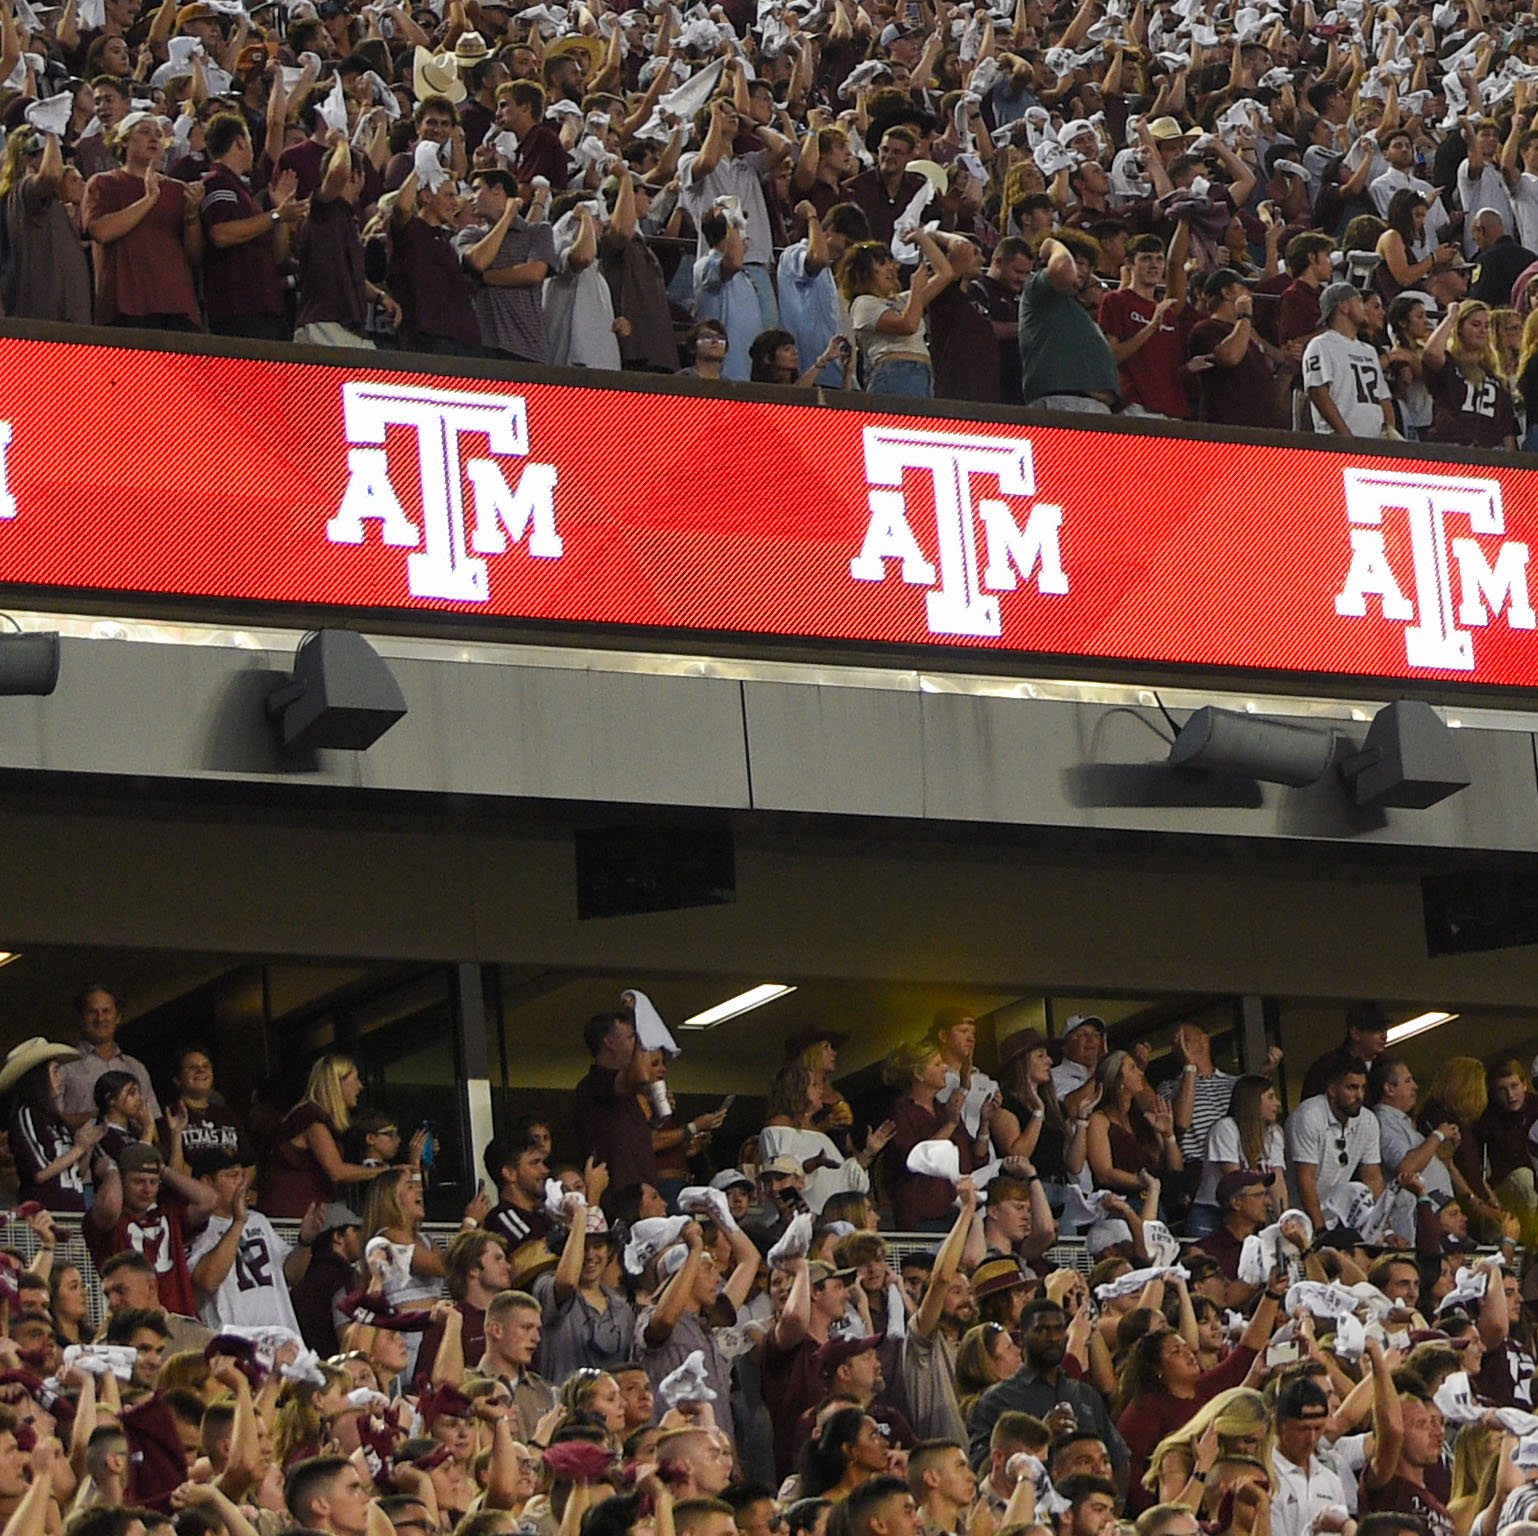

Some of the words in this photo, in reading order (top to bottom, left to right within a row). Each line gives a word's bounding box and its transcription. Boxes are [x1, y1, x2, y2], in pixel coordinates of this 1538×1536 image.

[1306, 355, 1322, 373] 12
[1350, 363, 1379, 404] 12
[1461, 376, 1498, 418] 12
[181, 1128, 219, 1146] TEXAS
[236, 1237, 274, 1292] 12
